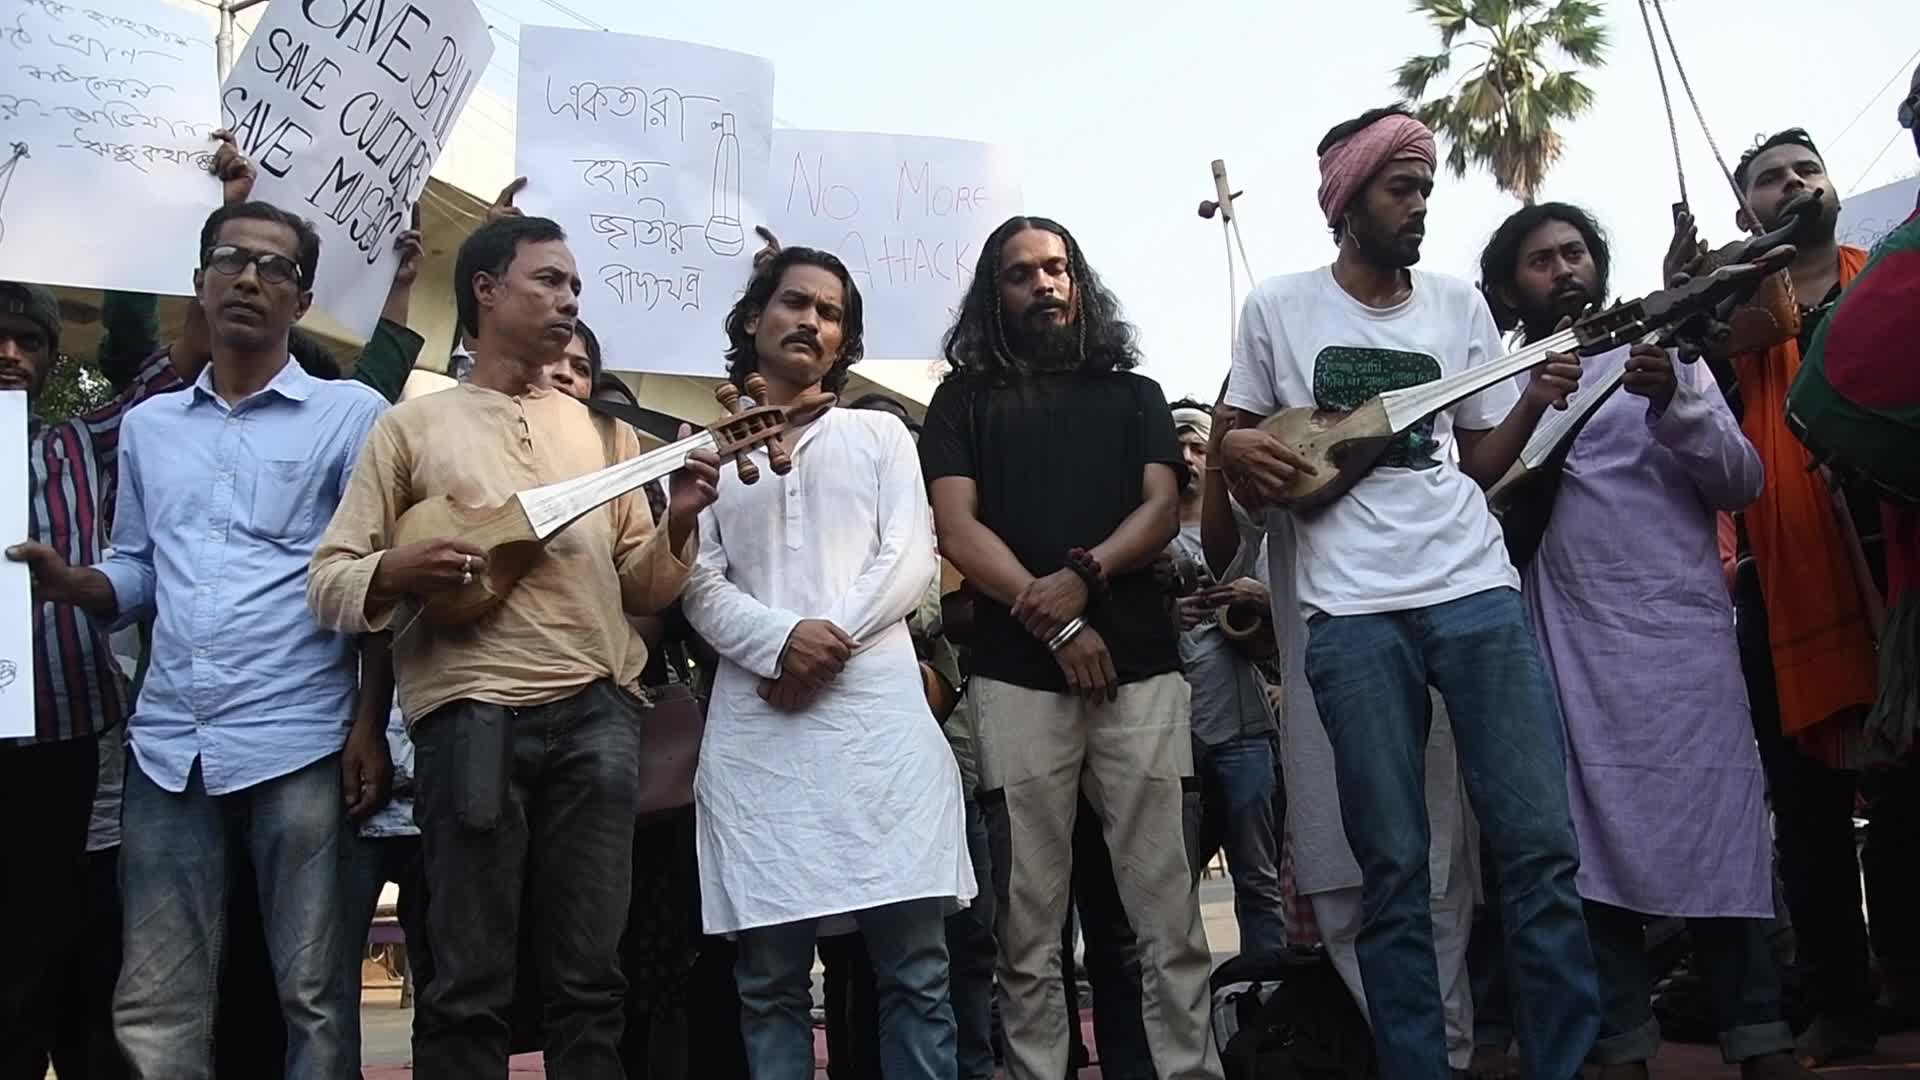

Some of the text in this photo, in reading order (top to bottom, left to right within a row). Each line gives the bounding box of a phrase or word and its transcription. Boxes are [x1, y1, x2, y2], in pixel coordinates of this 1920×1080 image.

[222, 86, 313, 178] SAVE
[255, 28, 342, 111] SAVE
[339, 91, 432, 210] CULTURE
[547, 75, 720, 143] একতারা
